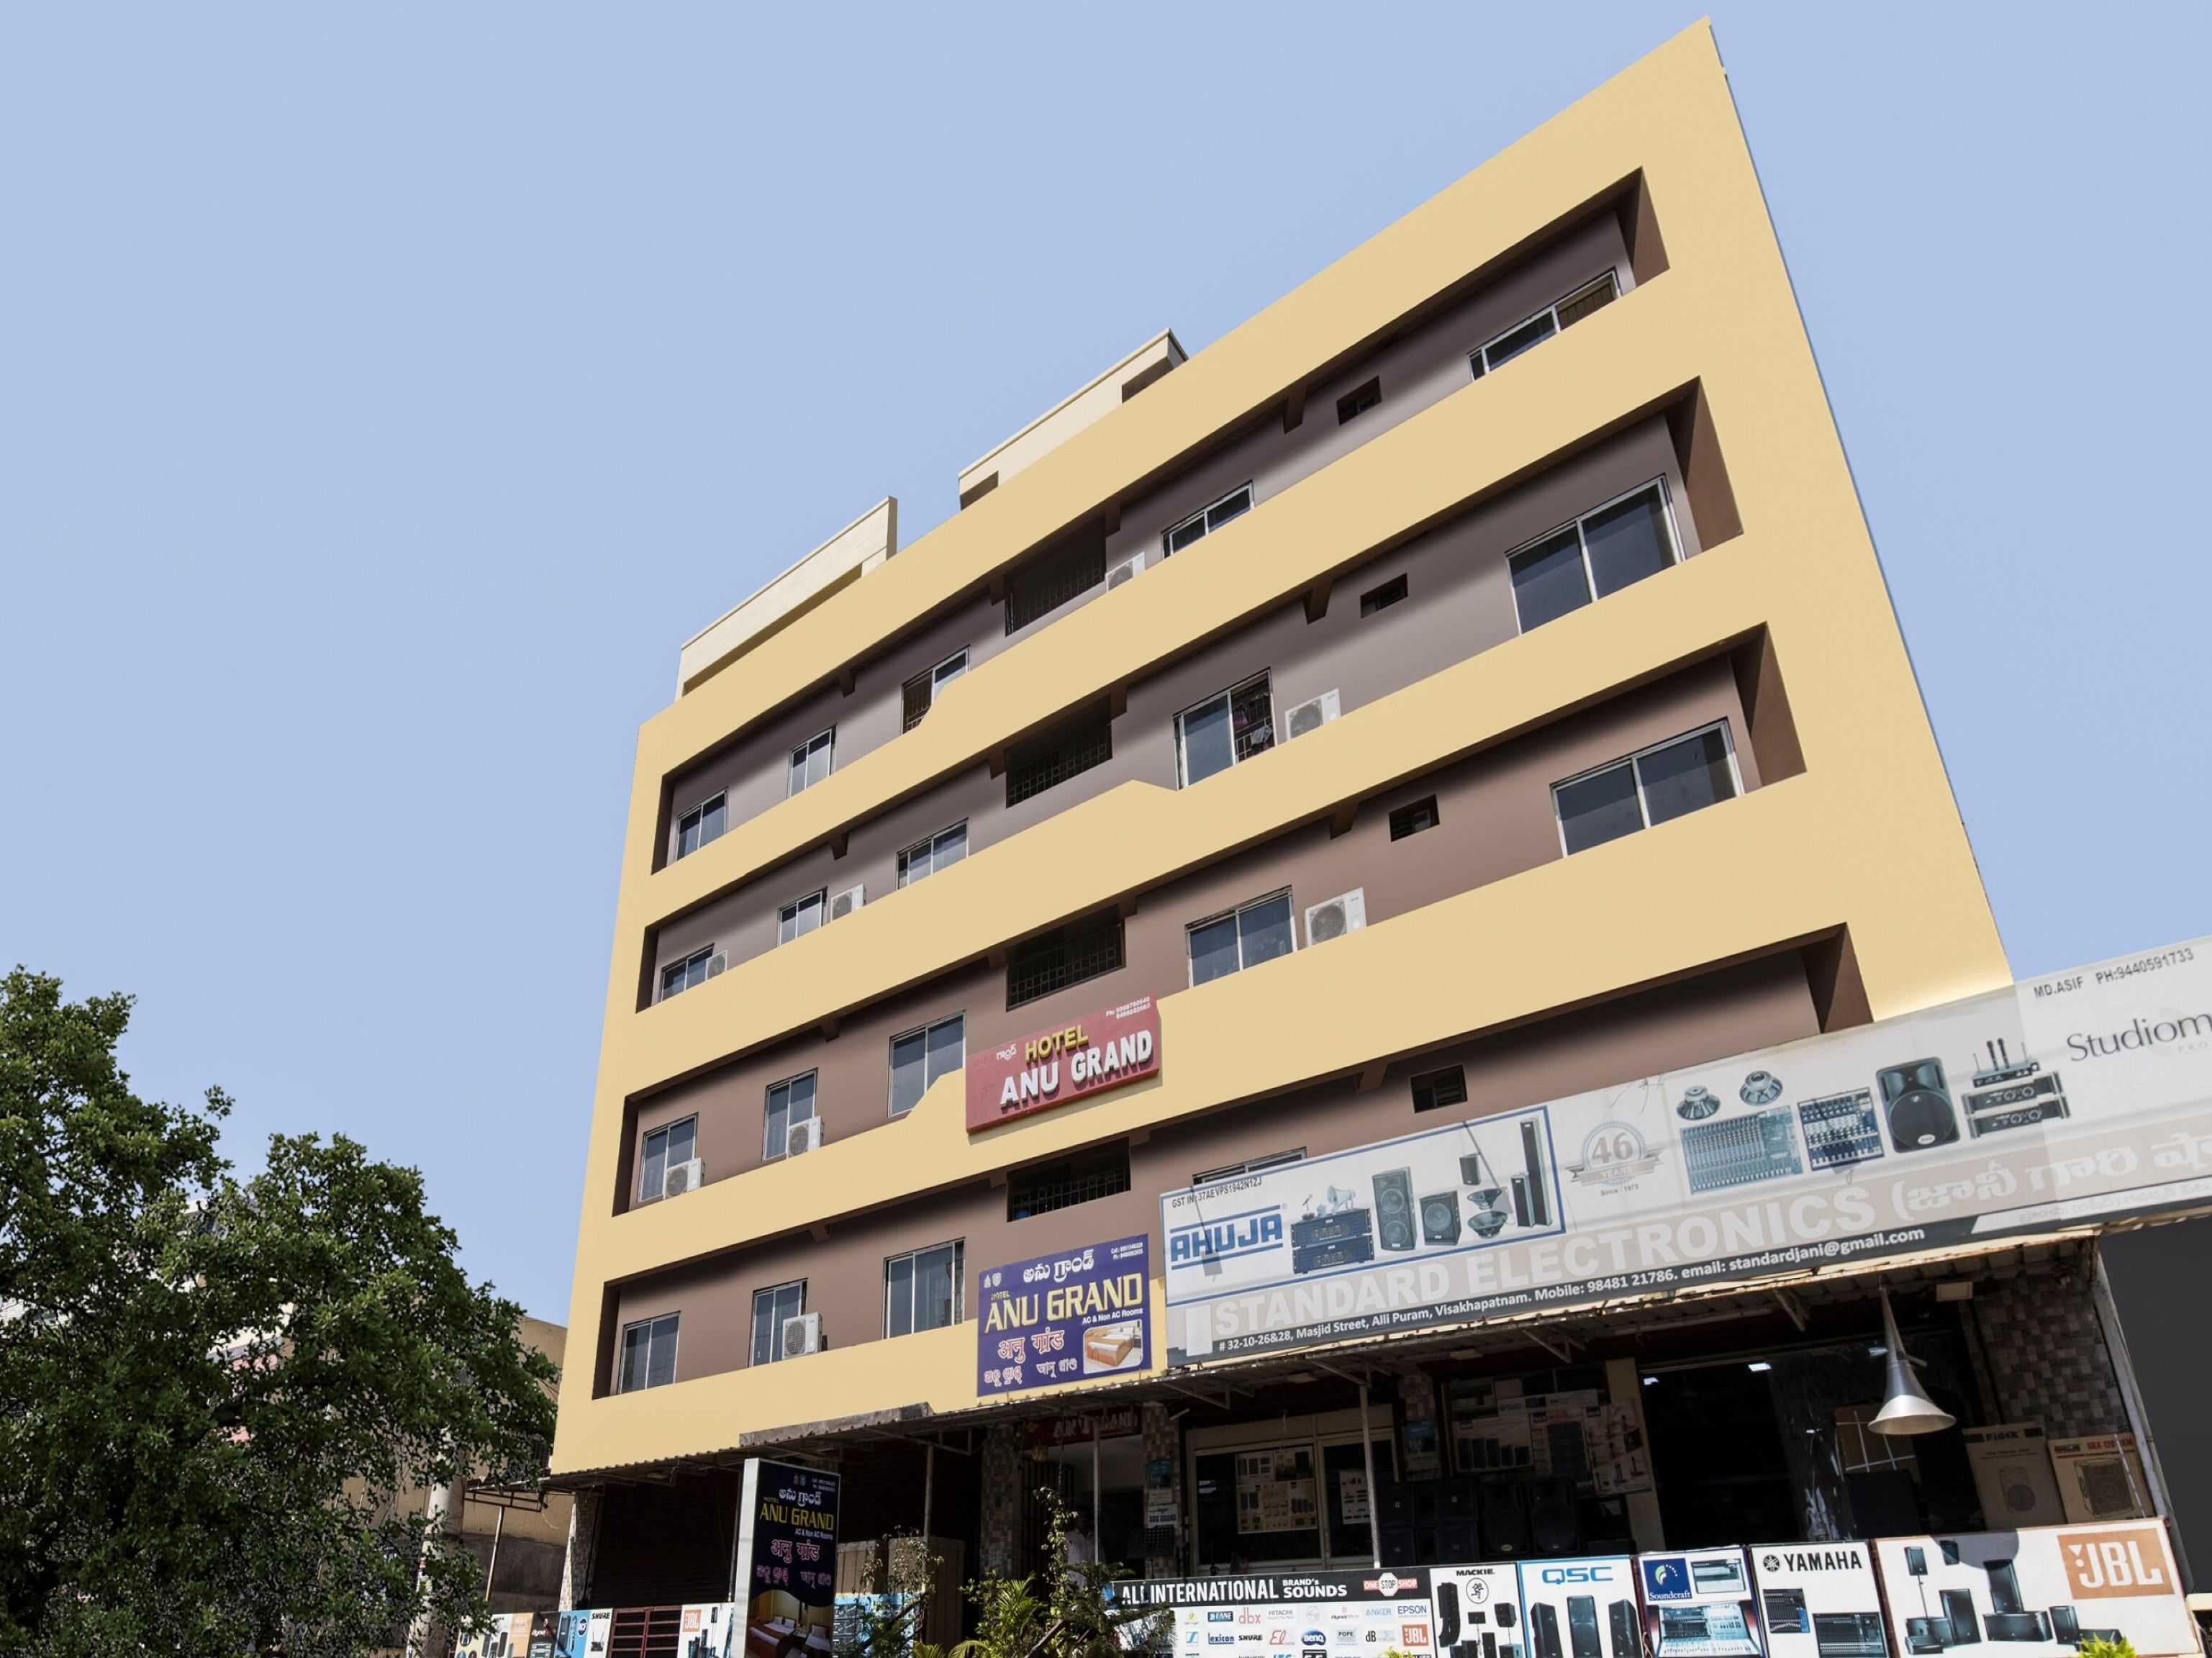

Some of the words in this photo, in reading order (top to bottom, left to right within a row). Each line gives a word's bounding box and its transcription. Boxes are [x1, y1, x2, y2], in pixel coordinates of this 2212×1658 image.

[2034, 978, 2084, 999] MD.ASIF
[1025, 1024, 1088, 1061] HOTEL
[1000, 1061, 1059, 1106] ANU
[1071, 1029, 1151, 1082] GRAND
[1591, 1132, 1633, 1164] 46
[1171, 1196, 1185, 1208] GST
[1170, 1213, 1282, 1262] AHUJA
[1214, 1264, 1449, 1337] STANDARD
[1468, 1186, 1876, 1310] ELECTRONICS
[991, 1290, 1010, 1301] HOTEL
[1219, 1341, 1225, 1351] #
[1227, 1329, 1294, 1351] 32-10-26&28,
[1296, 1322, 1332, 1346] Masjid
[1334, 1315, 1369, 1336] Street,
[1372, 1312, 1390, 1328] Alli
[1392, 1306, 1433, 1326] Puram,
[1434, 1292, 1532, 1320] Visakhapatnam.
[1535, 1281, 1585, 1302] Mobile:
[1587, 1277, 1628, 1294] 98481
[1681, 1261, 1726, 1279] email:
[1729, 1226, 1925, 1272] standardjani@gmail.com
[984, 1293, 1039, 1333] ANU
[1047, 1272, 1143, 1321] GRAND
[1098, 1313, 1110, 1322] Non
[1122, 1308, 1143, 1318] Rooms
[997, 1337, 1026, 1364] अनु
[760, 1503, 789, 1524] ANU
[791, 1508, 834, 1531] GRAND
[1783, 1550, 1863, 1572] YAMAHA
[2079, 1540, 2162, 1589] JBL
[1282, 1577, 1320, 1587] BRAND's
[1364, 1581, 1378, 1590] ONE
[1381, 1580, 1396, 1589] STOP
[1398, 1578, 1418, 1588] SHOP
[1542, 1566, 1613, 1585] QSC
[1121, 1585, 1149, 1605] ALL
[1151, 1578, 1279, 1604] INTERNATIONAL
[1283, 1585, 1348, 1599] SOUNDS
[1649, 1589, 1691, 1600] Soundcraft
[1238, 1606, 1261, 1624] dbx
[1365, 1608, 1392, 1616] ANKER
[1397, 1605, 1427, 1614] EPSON
[684, 1610, 699, 1628] JBL
[1207, 1632, 1235, 1644] lexicon
[1365, 1631, 1377, 1642] dB
[1404, 1627, 1427, 1644] JBL
